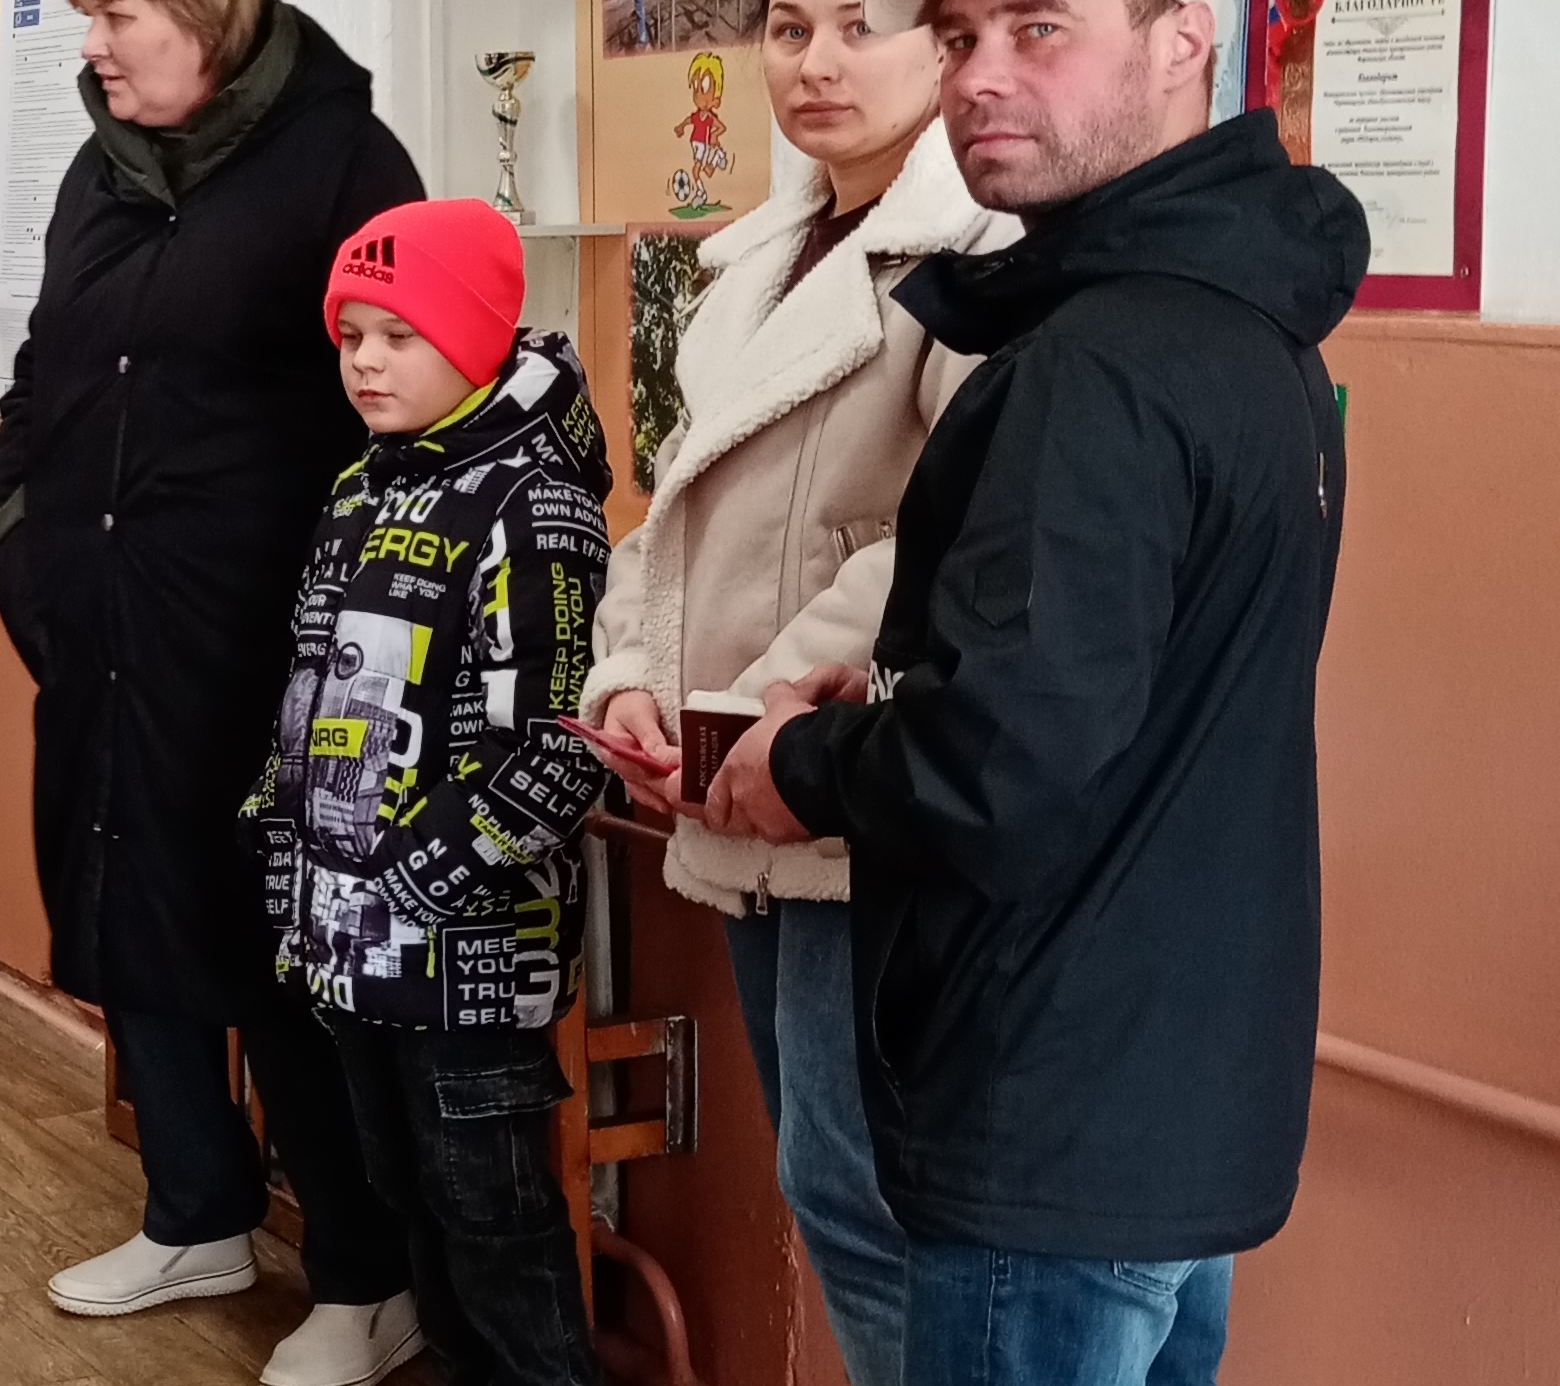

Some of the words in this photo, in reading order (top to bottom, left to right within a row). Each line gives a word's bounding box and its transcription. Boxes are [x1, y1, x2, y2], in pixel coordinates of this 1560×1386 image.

[342, 261, 395, 285] adidas
[528, 488, 573, 502] MAKE
[531, 503, 571, 518] OWN
[536, 533, 578, 553] REAL
[551, 562, 572, 641] DOING
[568, 576, 586, 629] YOU
[548, 646, 569, 710] KEEP
[467, 793, 491, 817] NO
[509, 769, 578, 818] SELF
[383, 867, 419, 911] MAKE
